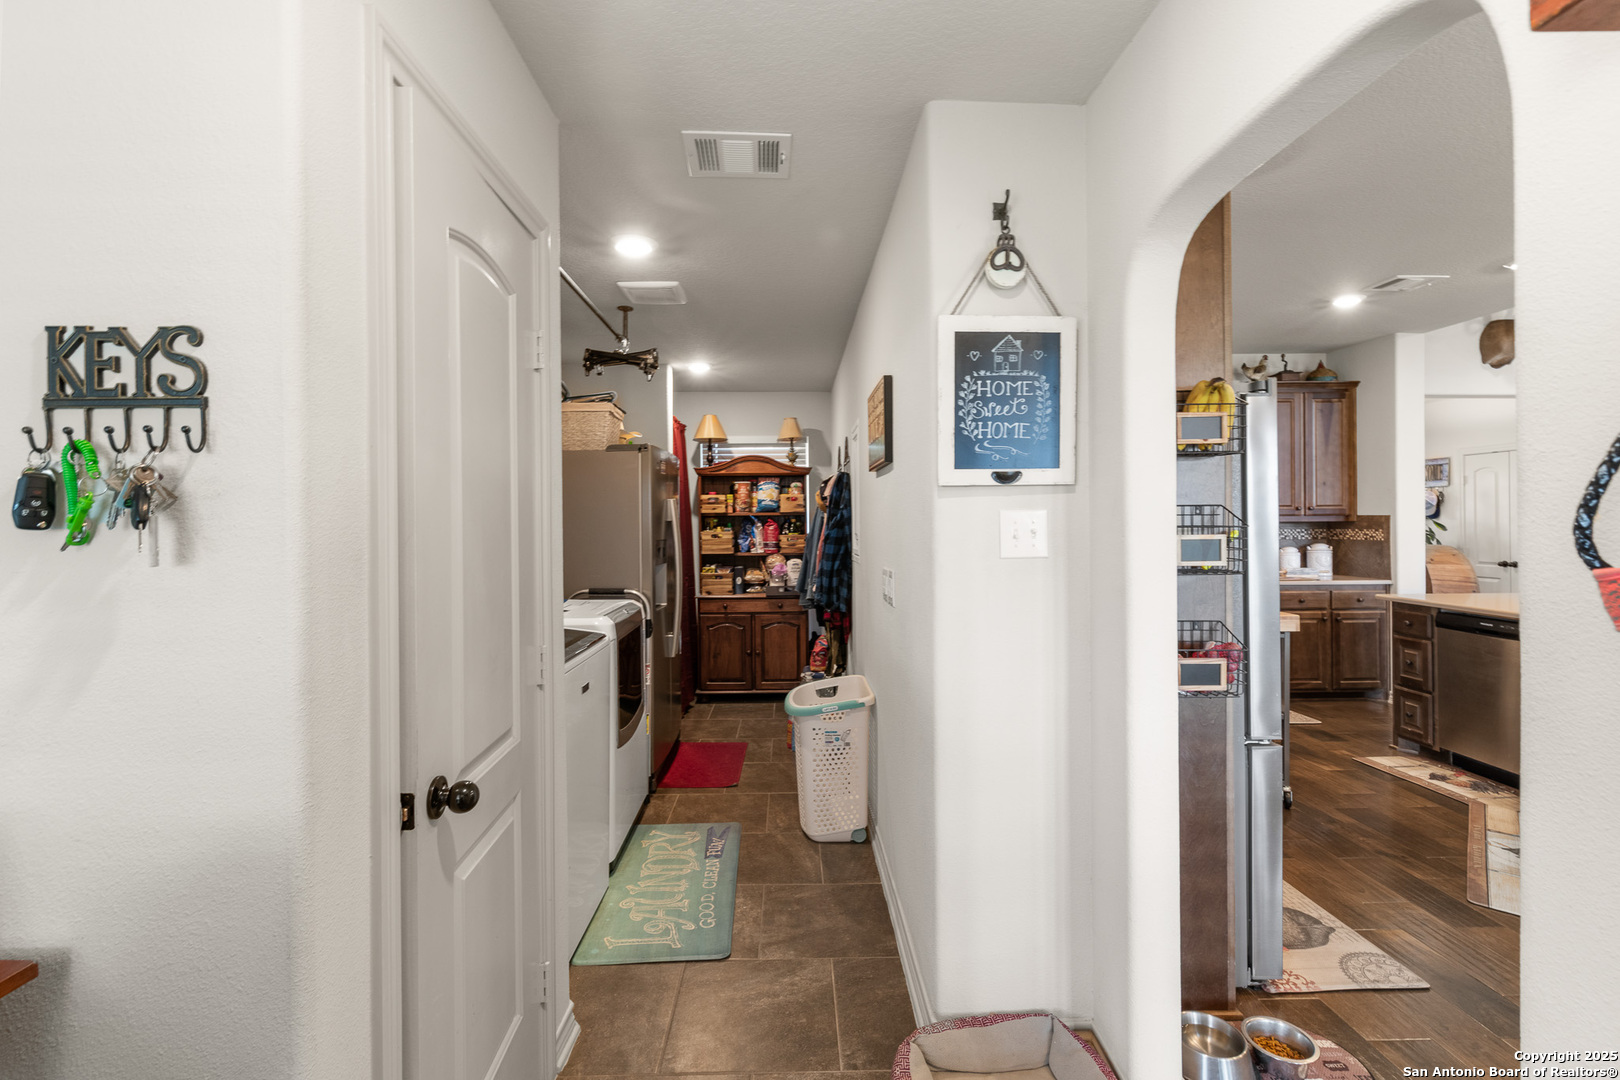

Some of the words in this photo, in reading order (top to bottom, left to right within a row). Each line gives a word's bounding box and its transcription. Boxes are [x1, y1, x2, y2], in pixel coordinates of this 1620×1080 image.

[45, 325, 208, 398] KEYS
[976, 380, 1034, 397] HOME
[970, 397, 1028, 419] Sweet
[977, 421, 1032, 439] HOME
[702, 859, 720, 889] CLEAN
[604, 830, 701, 949] LAUNDRY
